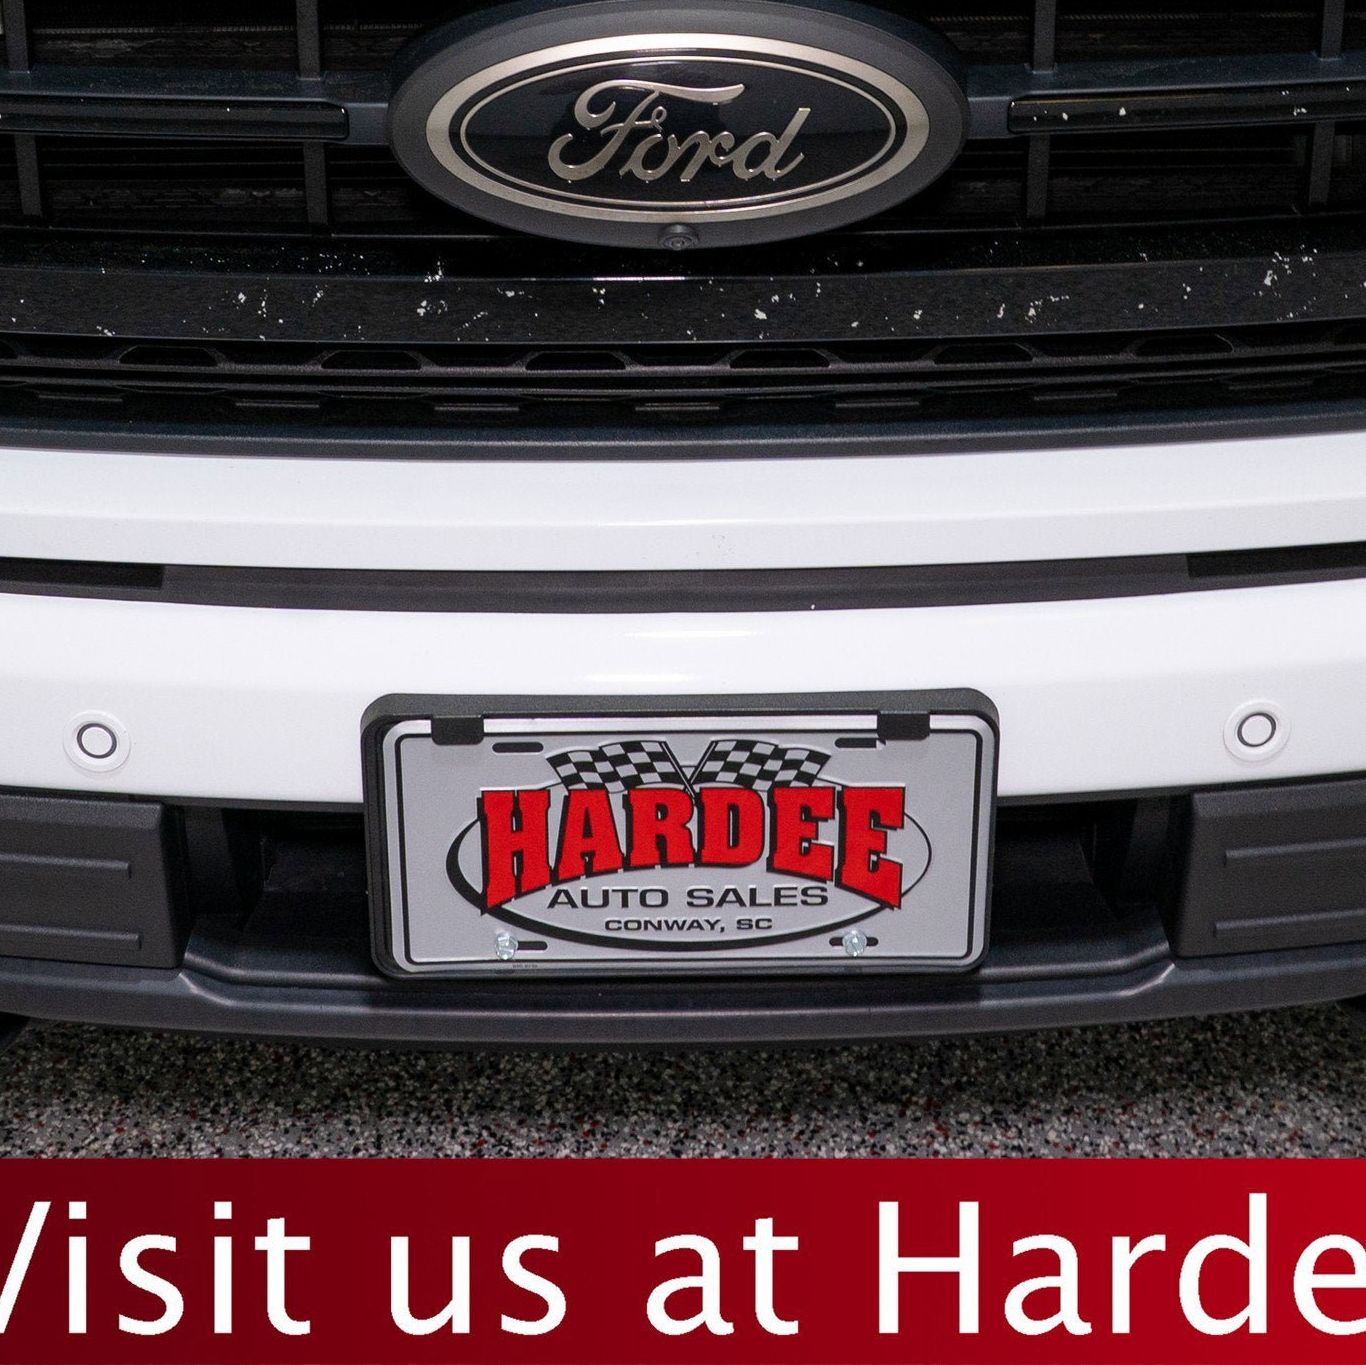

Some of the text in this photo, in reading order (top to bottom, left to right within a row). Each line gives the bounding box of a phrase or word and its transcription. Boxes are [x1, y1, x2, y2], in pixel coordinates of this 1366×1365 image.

[547, 78, 812, 183] Ford
[479, 785, 907, 912] HARDEE
[546, 885, 829, 910] AUTO SALES
[604, 918, 773, 933] CONWAY, SC
